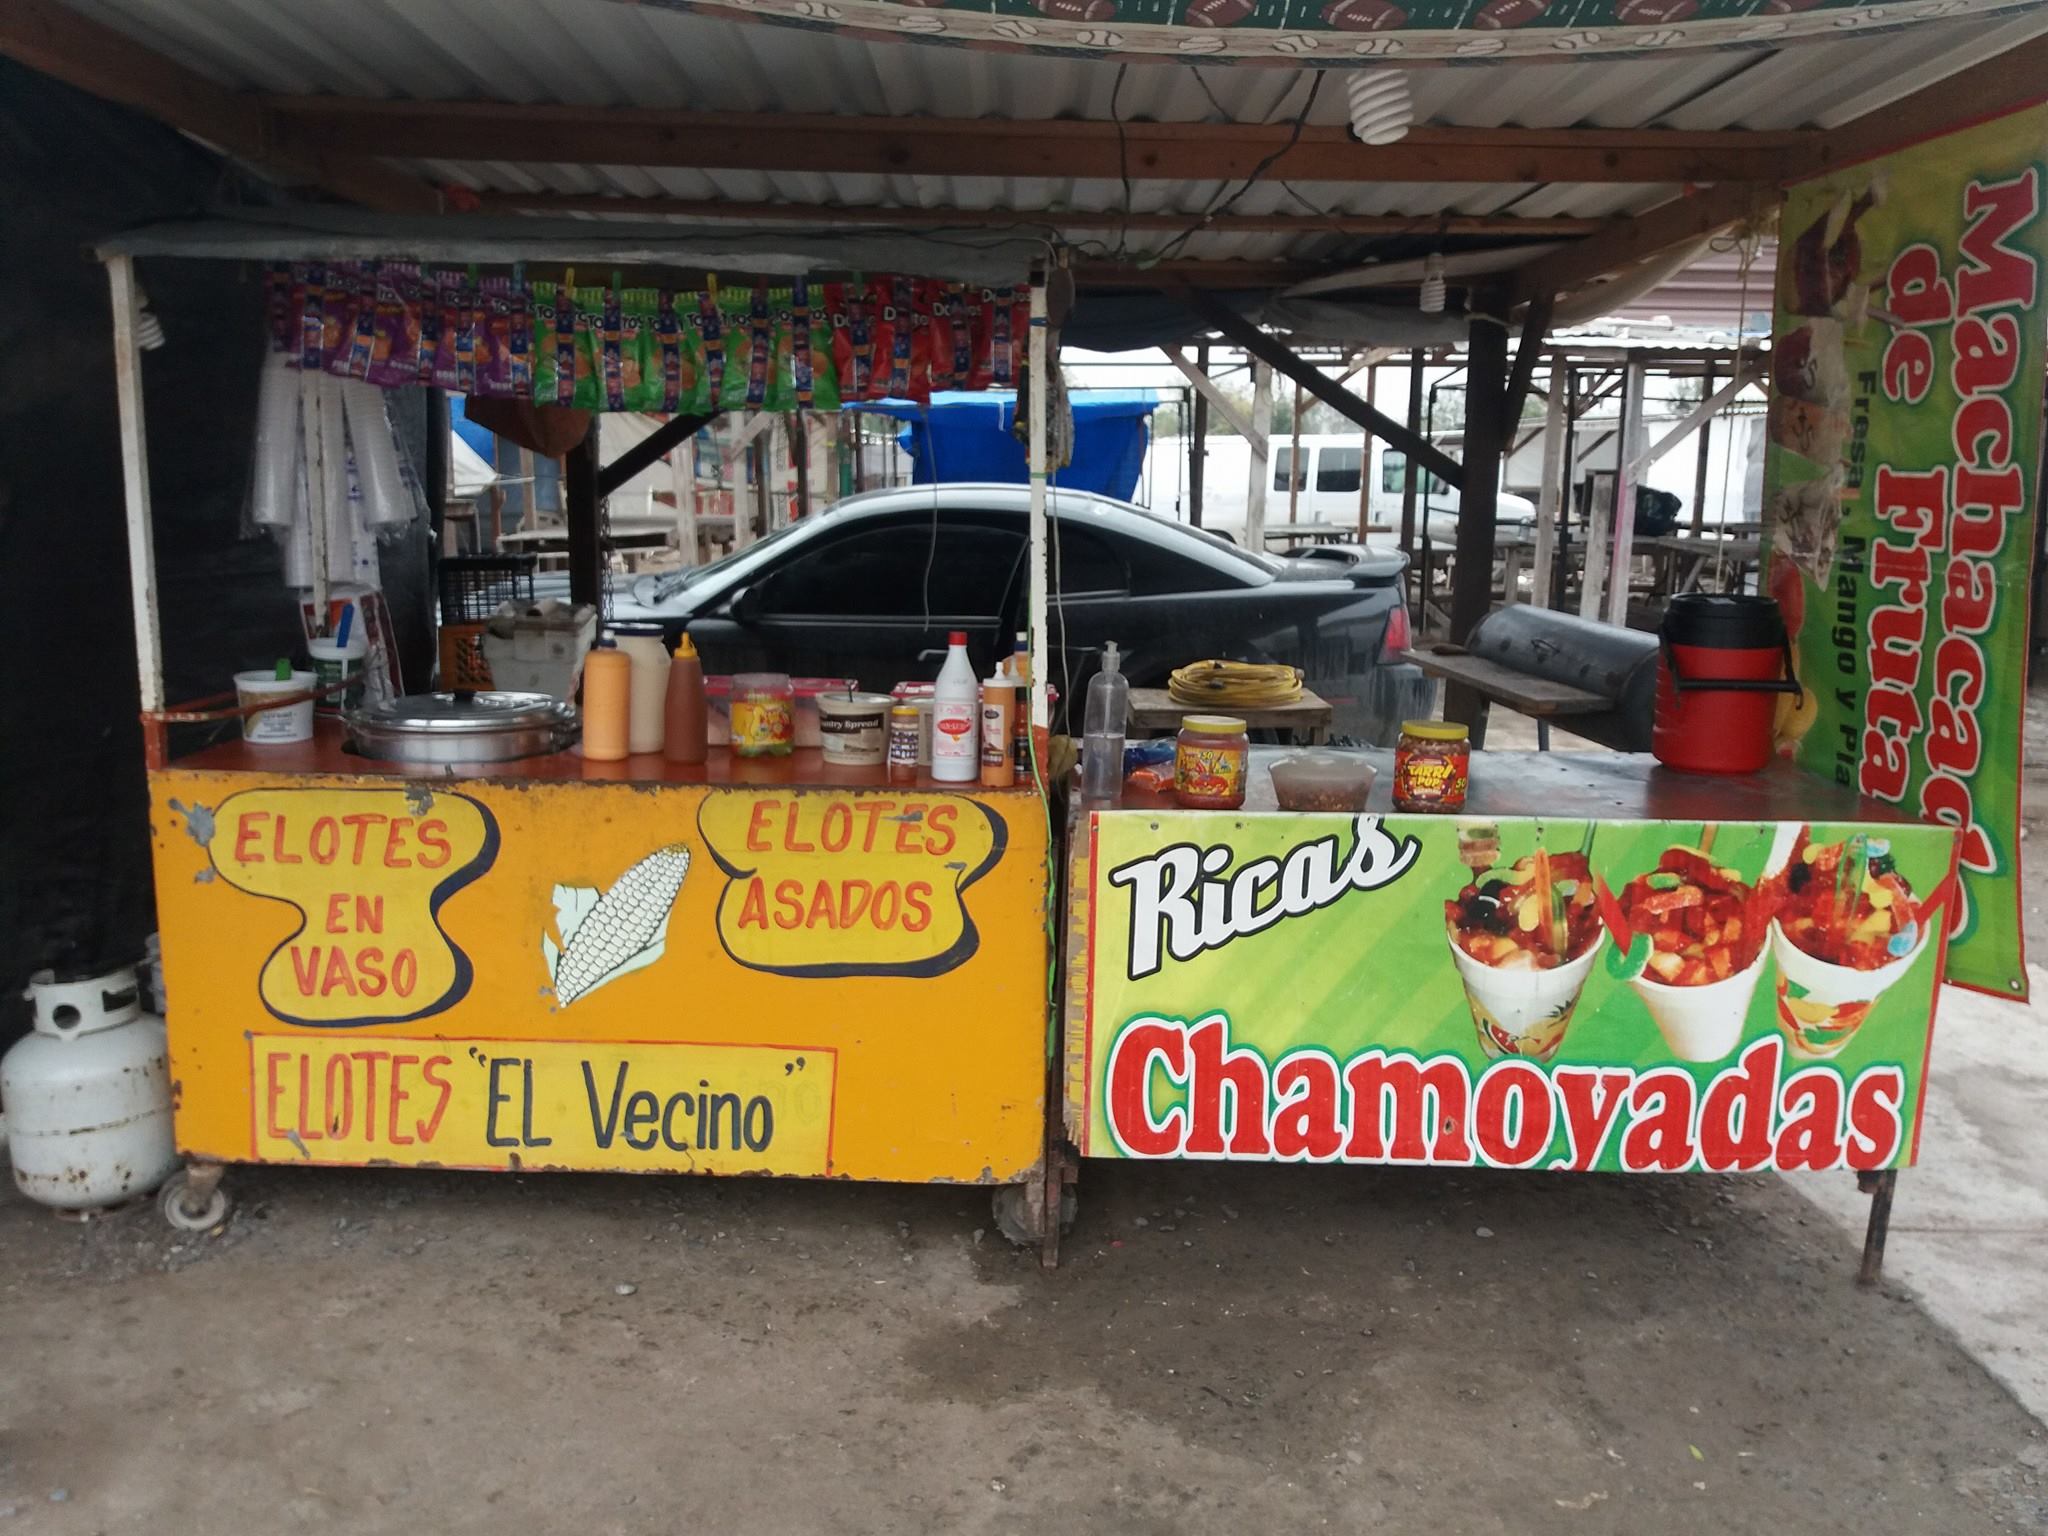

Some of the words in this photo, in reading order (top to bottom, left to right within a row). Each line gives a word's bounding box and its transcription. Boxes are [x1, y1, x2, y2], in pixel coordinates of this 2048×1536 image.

[1882, 242, 1953, 405] de
[1919, 167, 2039, 941] Machacad
[1832, 535, 1866, 675] Mango
[1859, 464, 1949, 802] Fruta
[1836, 687, 1856, 711] y
[1836, 724, 1858, 787] Pla
[233, 811, 452, 869] ELOTES
[746, 799, 959, 856] ELOTES
[325, 893, 383, 934] EN
[738, 876, 933, 932] ASADOS
[1109, 813, 1422, 980] Ricas
[290, 946, 418, 998] VASO
[267, 1050, 453, 1145] ELOTES
[1107, 1012, 1904, 1173] Chamoyadas
